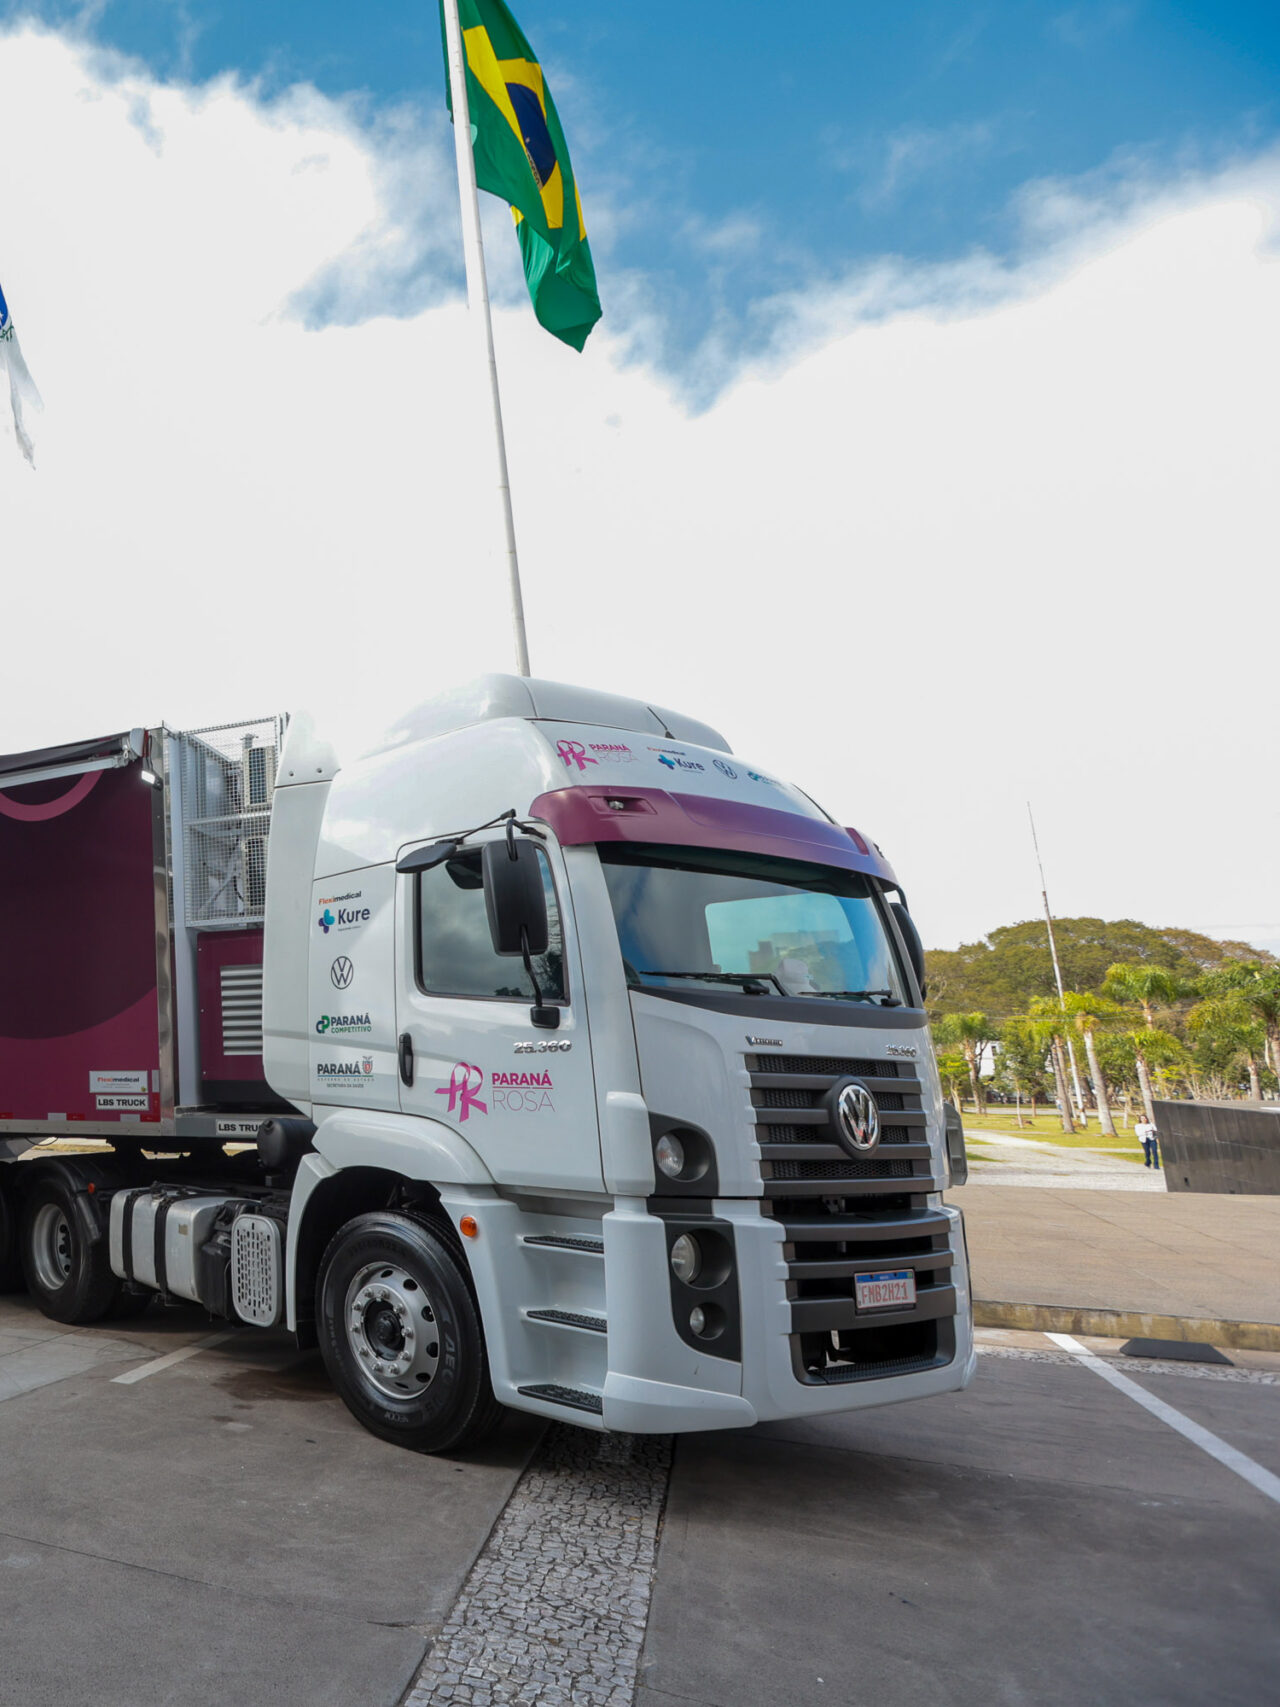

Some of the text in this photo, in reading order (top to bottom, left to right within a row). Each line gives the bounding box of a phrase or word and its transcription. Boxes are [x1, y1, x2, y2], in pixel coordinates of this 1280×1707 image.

[673, 757, 705, 771] Kure
[318, 890, 362, 905] Fleximedical
[338, 908, 370, 925] Kure
[331, 1012, 371, 1026] PARANÁ
[331, 1025, 372, 1034] COMPETITIVO
[513, 1040, 572, 1054] 25.360
[317, 1061, 361, 1075] PARANÁ
[492, 1069, 553, 1086] PARANÁ
[98, 1098, 146, 1107] LBS TRUCK
[492, 1090, 556, 1112] ROSA
[218, 1123, 261, 1132] LBS TRU
